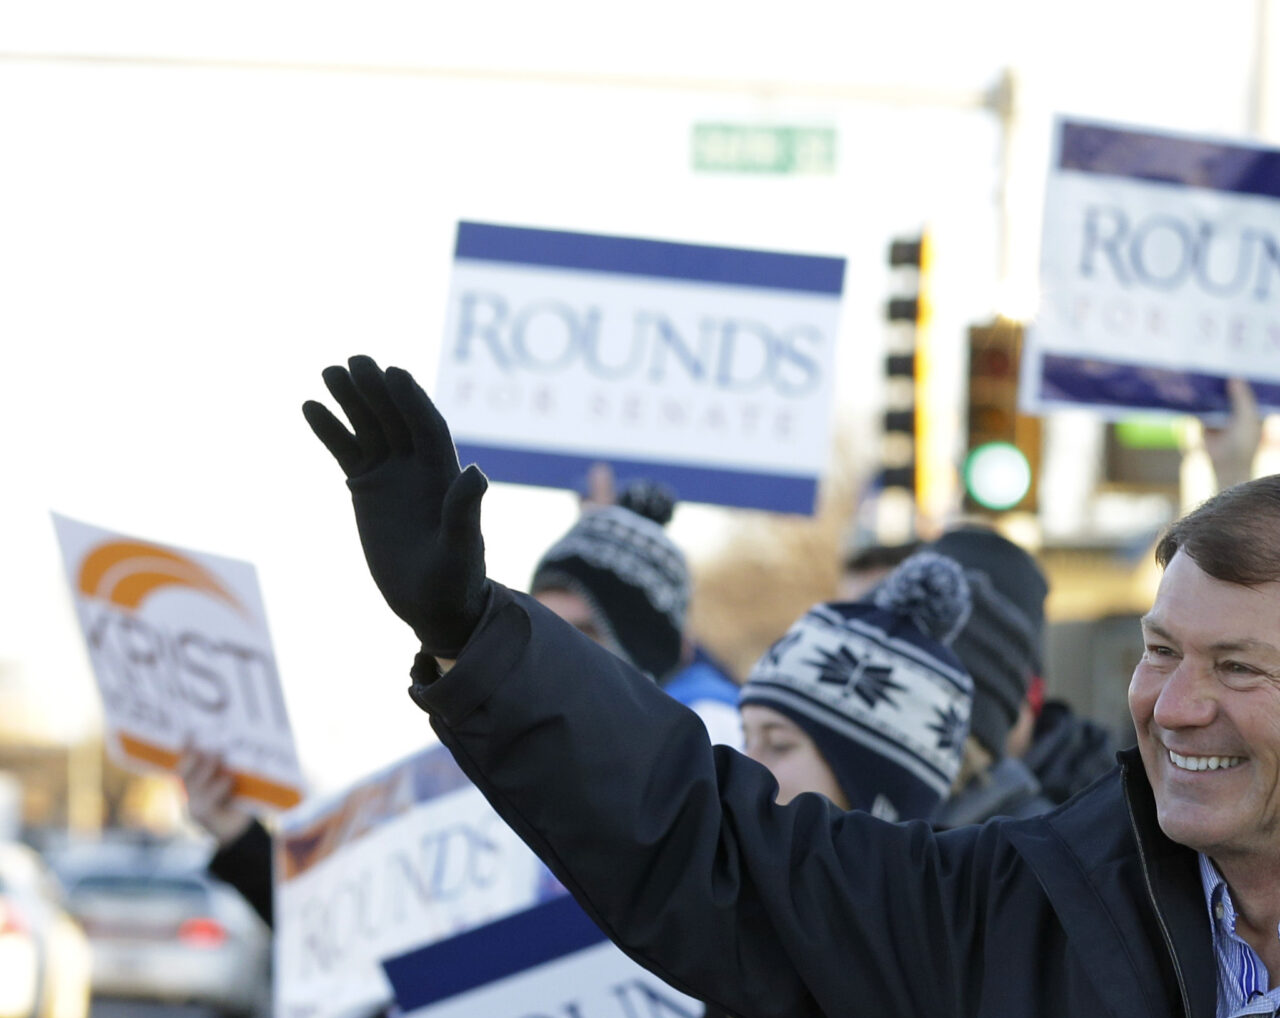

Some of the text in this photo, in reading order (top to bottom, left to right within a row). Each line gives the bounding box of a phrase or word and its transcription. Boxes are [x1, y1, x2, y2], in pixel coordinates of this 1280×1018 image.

[453, 288, 826, 398] ROUNDS
[454, 376, 799, 442] FOR SENATE
